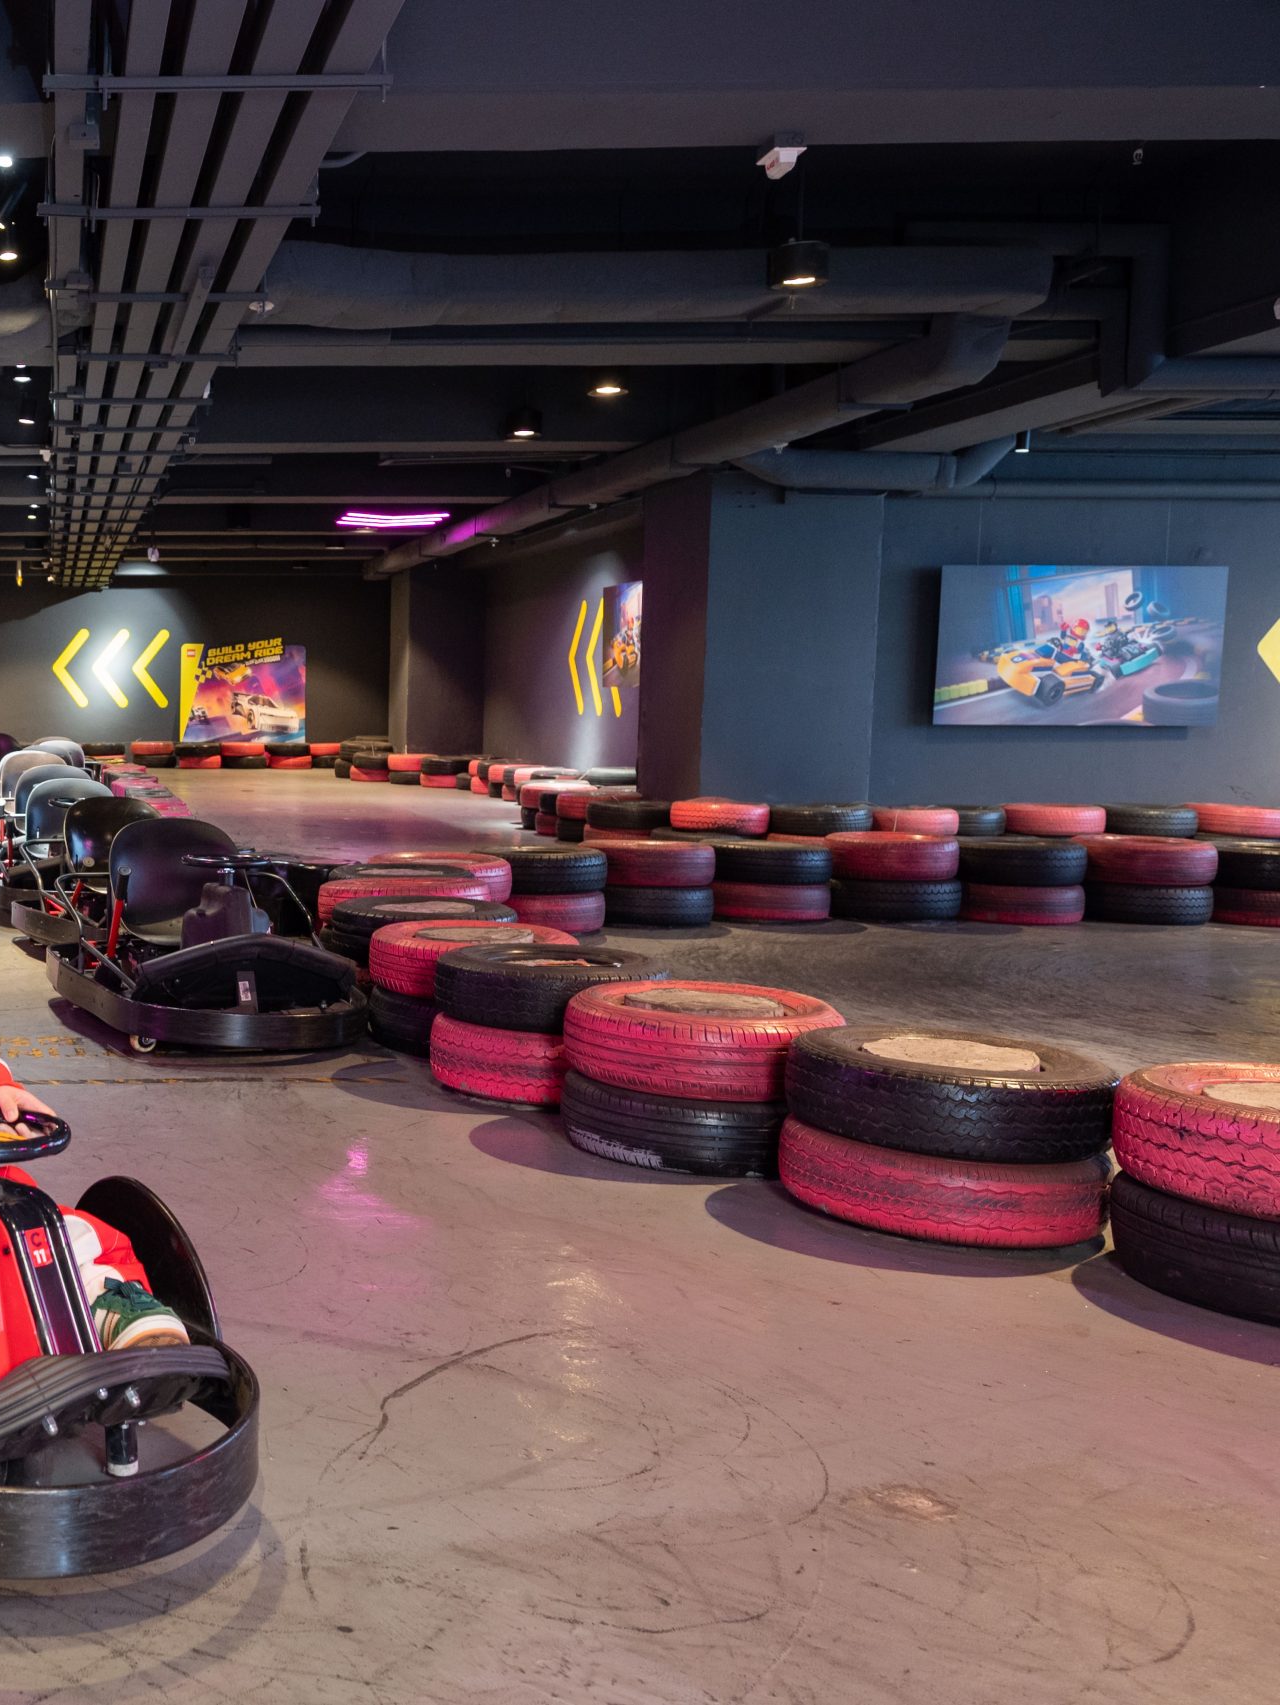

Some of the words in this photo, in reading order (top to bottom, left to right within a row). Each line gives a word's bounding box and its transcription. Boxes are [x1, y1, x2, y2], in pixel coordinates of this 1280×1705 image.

[206, 651, 251, 666] DREAM
[254, 645, 283, 658] RIDE
[208, 644, 244, 657] BUILD
[248, 637, 282, 650] YOUR
[30, 1232, 42, 1247] C
[33, 1248, 47, 1264] 11
